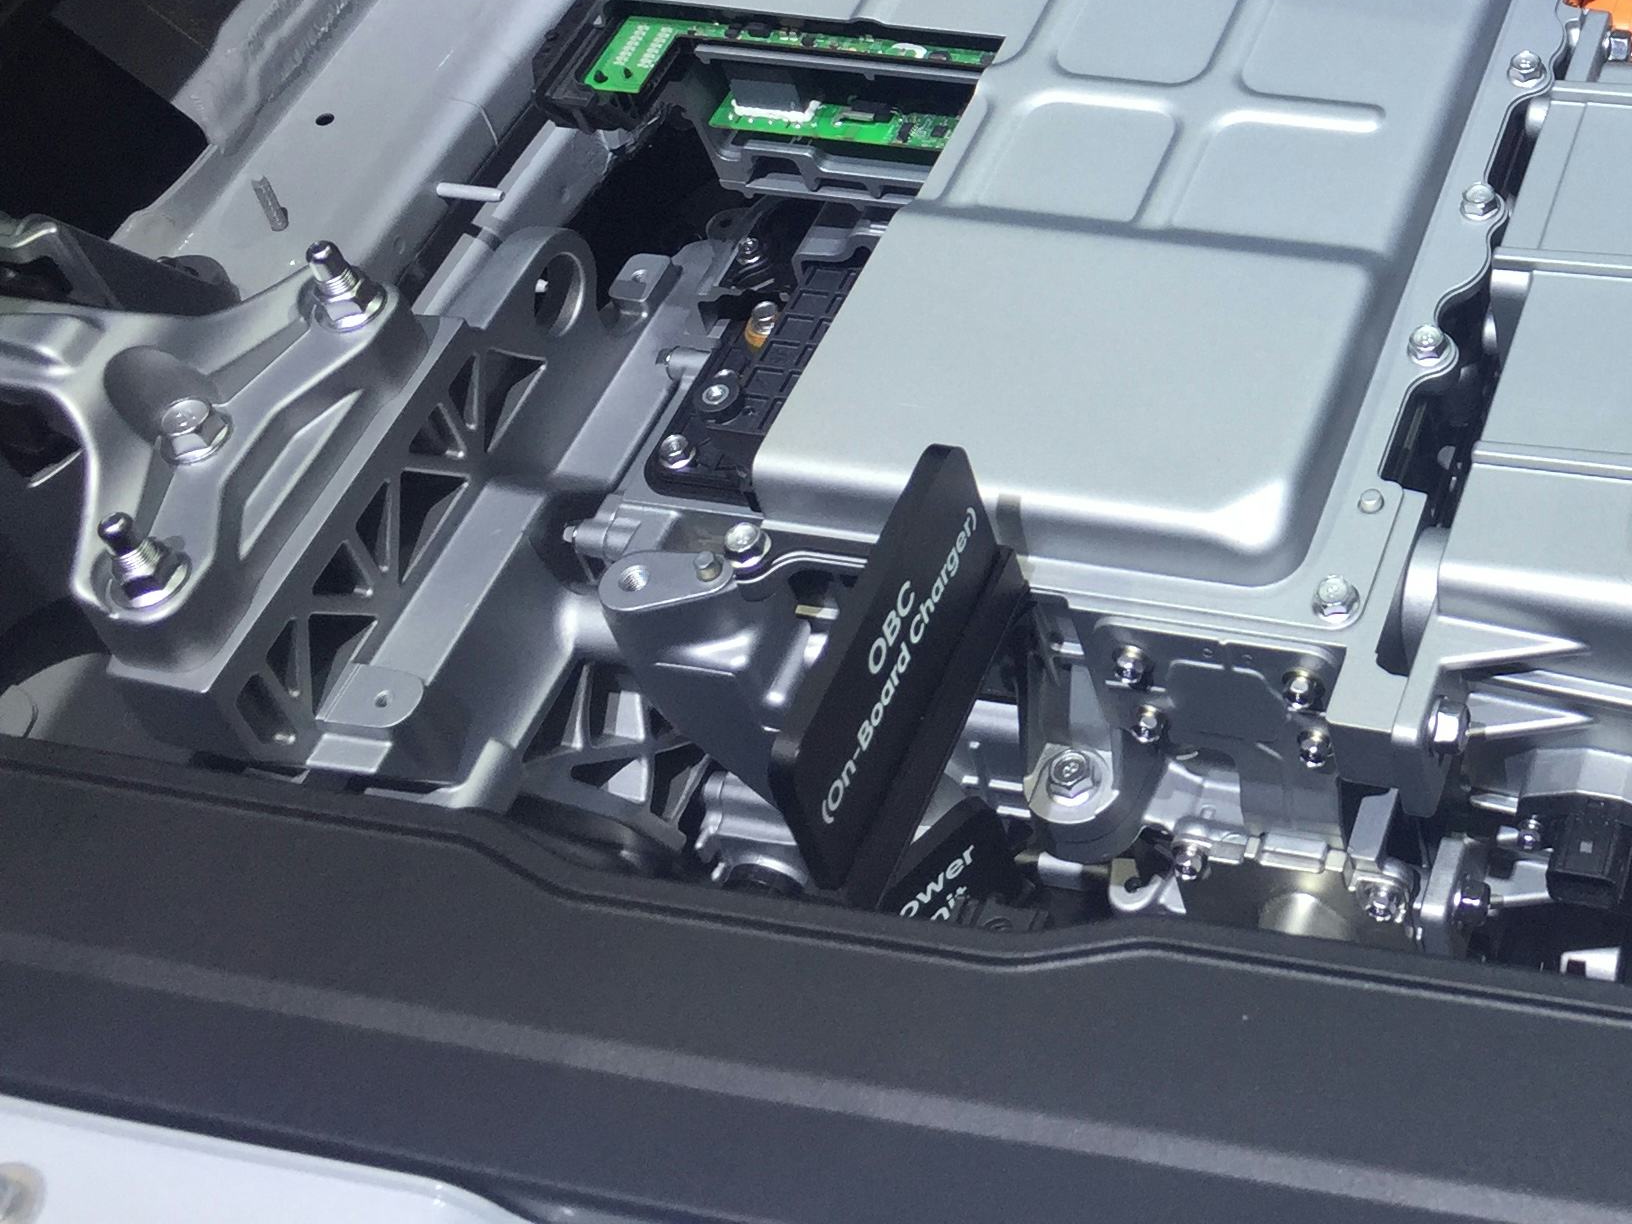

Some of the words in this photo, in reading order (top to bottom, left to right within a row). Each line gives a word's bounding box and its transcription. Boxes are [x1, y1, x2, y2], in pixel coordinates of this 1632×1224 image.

[822, 641, 911, 824] (On-Board
[909, 506, 977, 644] Charger)
[868, 580, 915, 674] OBC
[899, 844, 975, 917] ower
[930, 886, 969, 920] nit
